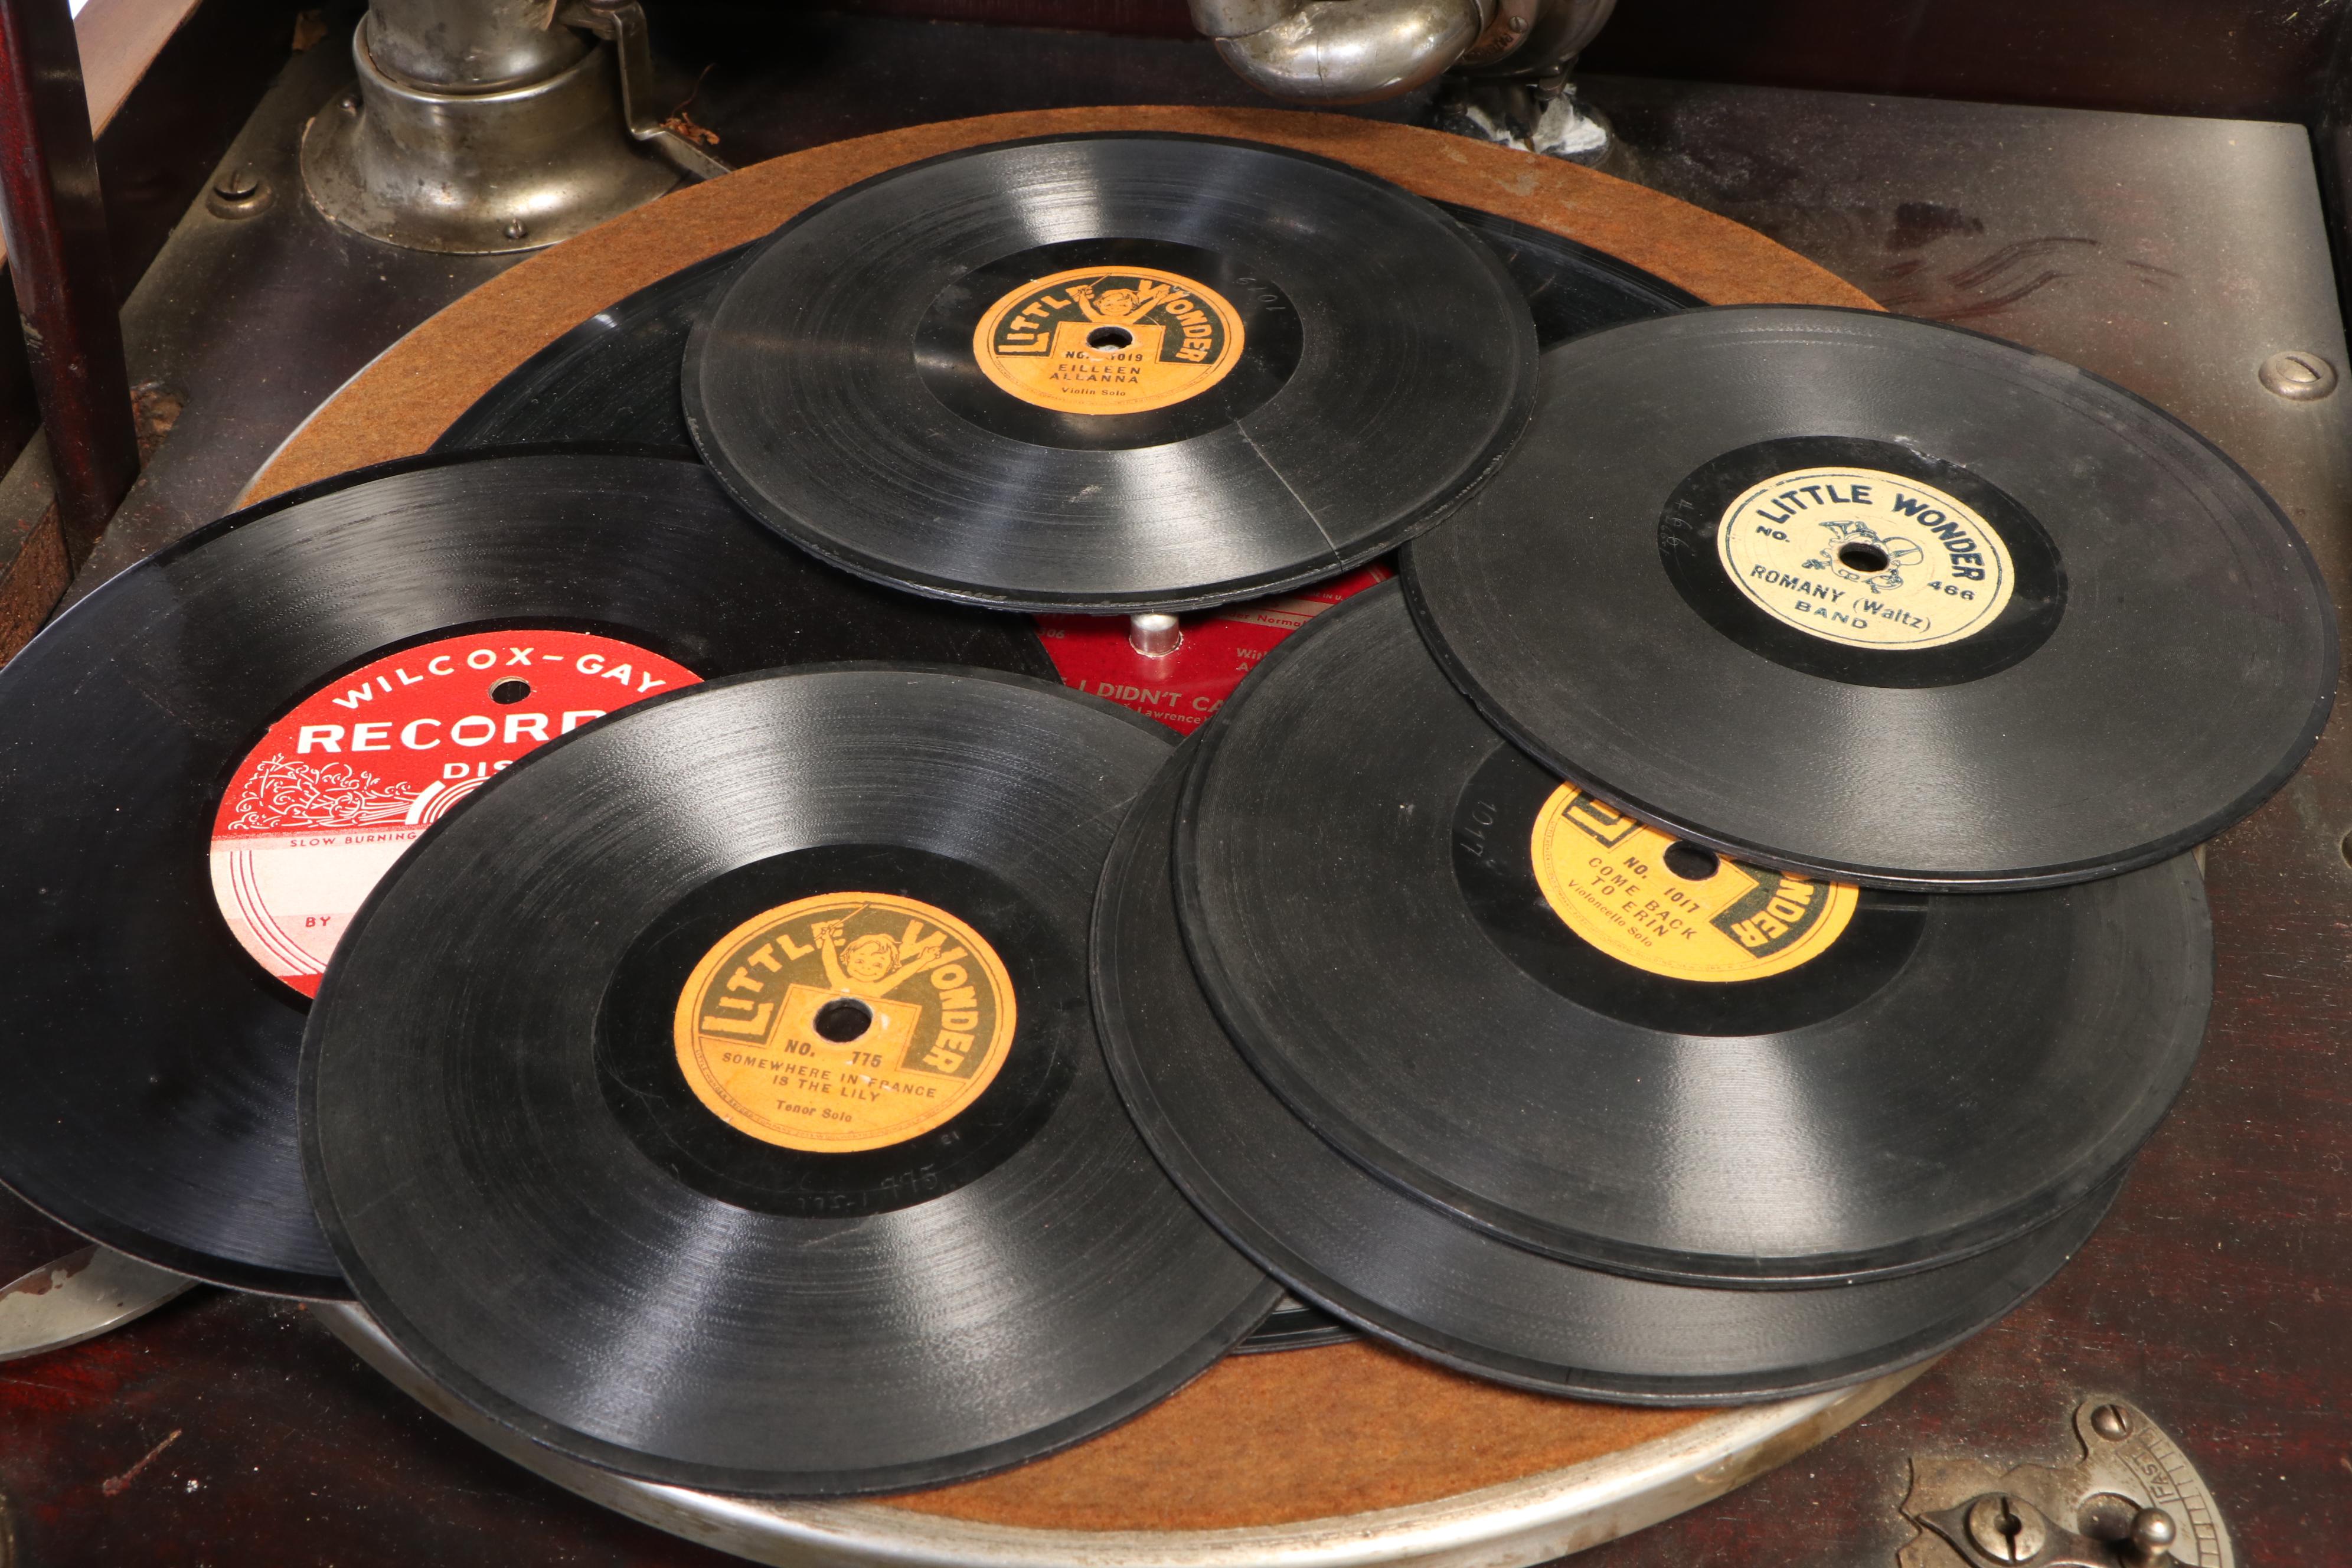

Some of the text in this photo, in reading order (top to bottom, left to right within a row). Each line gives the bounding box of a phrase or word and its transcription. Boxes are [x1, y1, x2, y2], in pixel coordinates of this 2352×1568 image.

[998, 279, 1213, 362] LITTLE WONDER
[1050, 373, 1138, 383] ALLANNA
[1059, 364, 1141, 375] EILLEEN
[1062, 387, 1096, 396] Violin
[1757, 484, 1985, 581] LITTLE WONDER
[1756, 525, 1975, 600] NO. 466
[1750, 564, 1932, 633] ROMANY (Waltz)
[1795, 600, 1868, 629] BAND
[333, 647, 666, 708] WILCOX-GAY
[1096, 681, 1182, 707] DIDN'T
[290, 832, 417, 848] SLOW BURNING
[1589, 857, 1639, 897] COME
[1645, 899, 1697, 940] BACK
[1590, 876, 1669, 937] TO ERIN
[1623, 857, 1700, 914] NO. 1017
[1731, 871, 1814, 948] NDER
[305, 916, 331, 928] BY
[1567, 879, 1626, 930] Violoncello
[1627, 925, 1652, 947] Solo
[702, 919, 978, 1073] LITTLE WONDER
[722, 1053, 936, 1098] SOMEWHERE IN FRANCE
[785, 1040, 883, 1068] NO. 775
[772, 1074, 881, 1103] IS THE LILY
[776, 1100, 852, 1122] Tenor Solo
[2131, 1451, 2175, 1499] FAST
